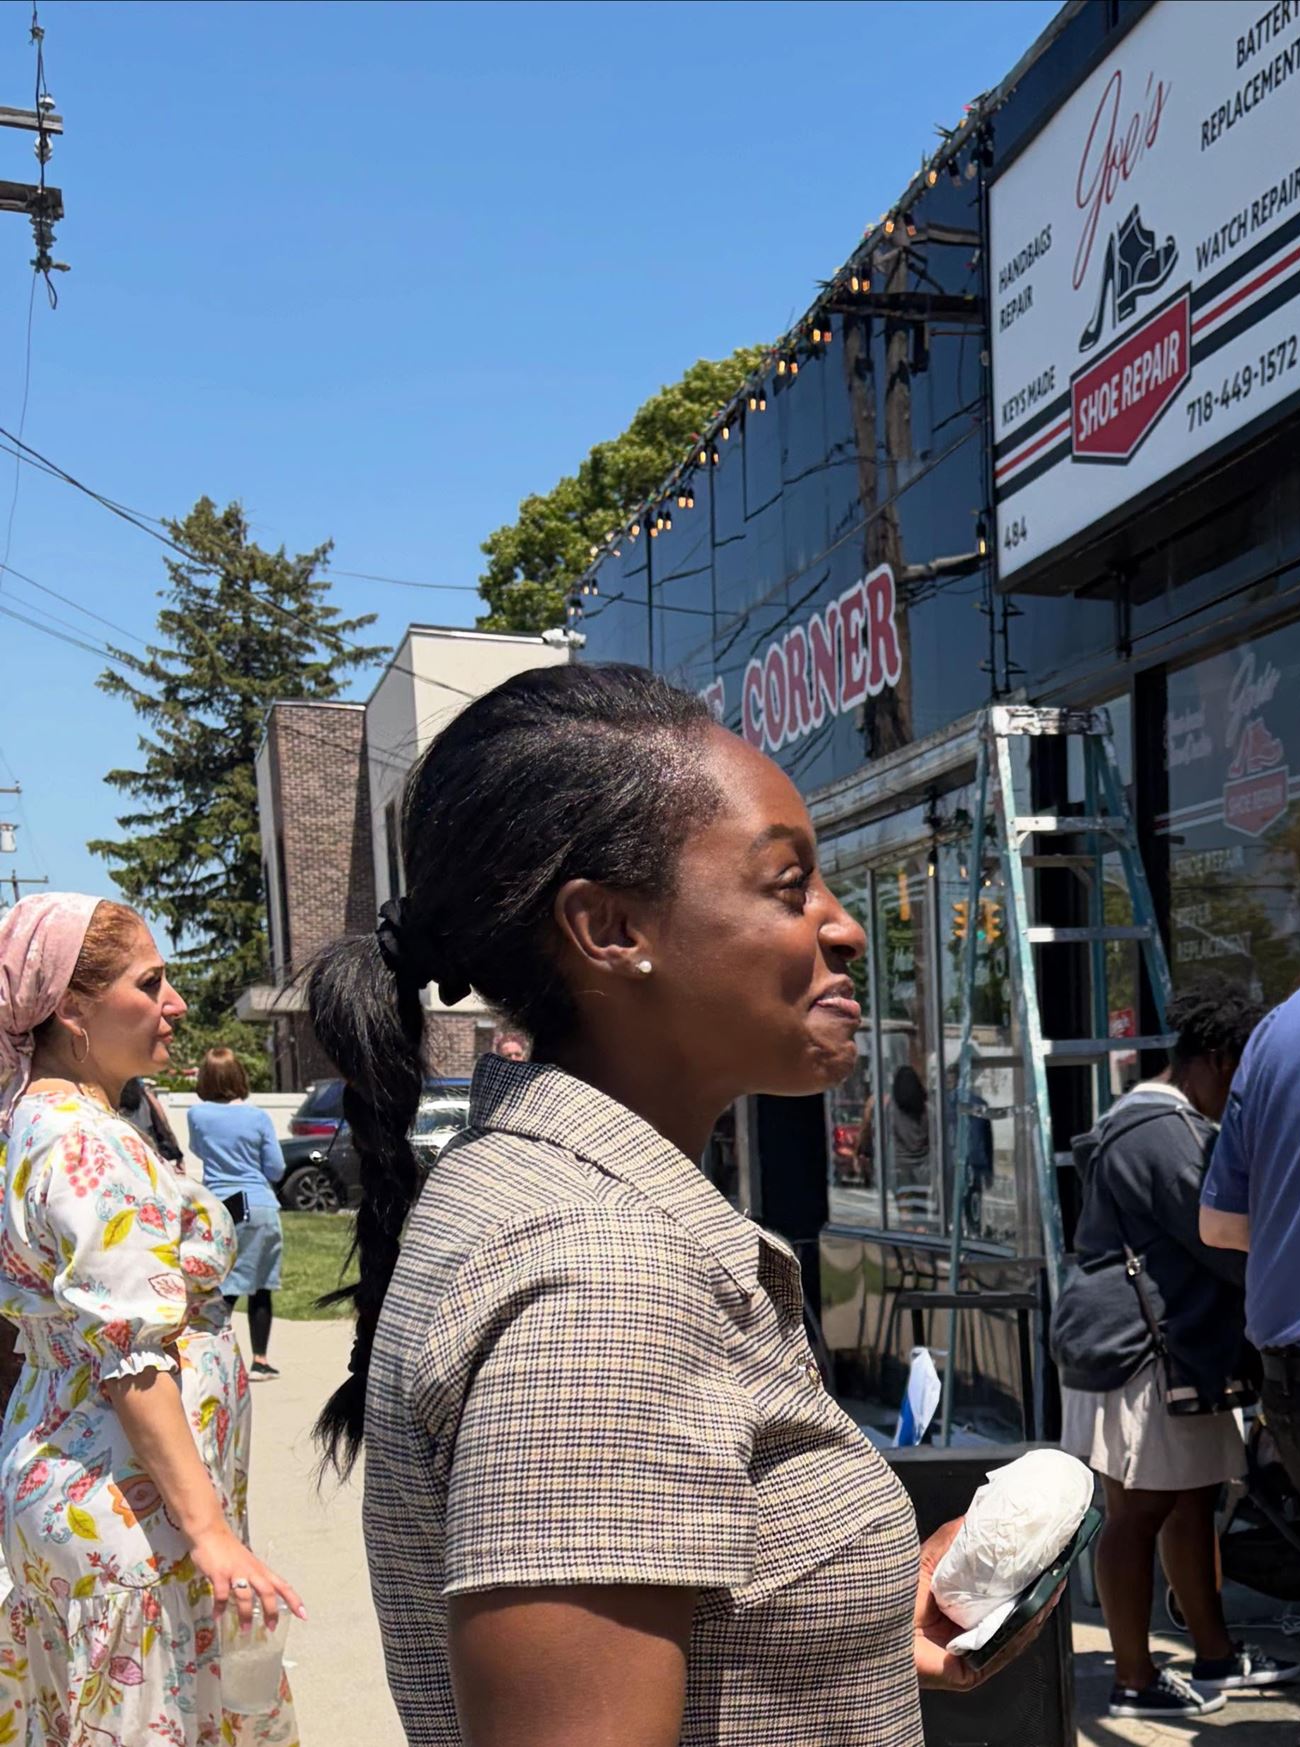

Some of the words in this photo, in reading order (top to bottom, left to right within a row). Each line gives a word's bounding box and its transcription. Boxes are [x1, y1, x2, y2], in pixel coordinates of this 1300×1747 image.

[1072, 69, 1172, 290] Joe's
[1196, 207, 1249, 273] WATCH
[998, 284, 1033, 334] REPAIR
[1001, 387, 1027, 428] KEYS
[1026, 364, 1057, 404] MADE
[1078, 370, 1121, 442] SHOE
[1120, 329, 1181, 412] REPAIR
[1186, 333, 1299, 433] 718-449-1572
[1003, 515, 1029, 551] 484
[743, 563, 901, 750] CORNER
